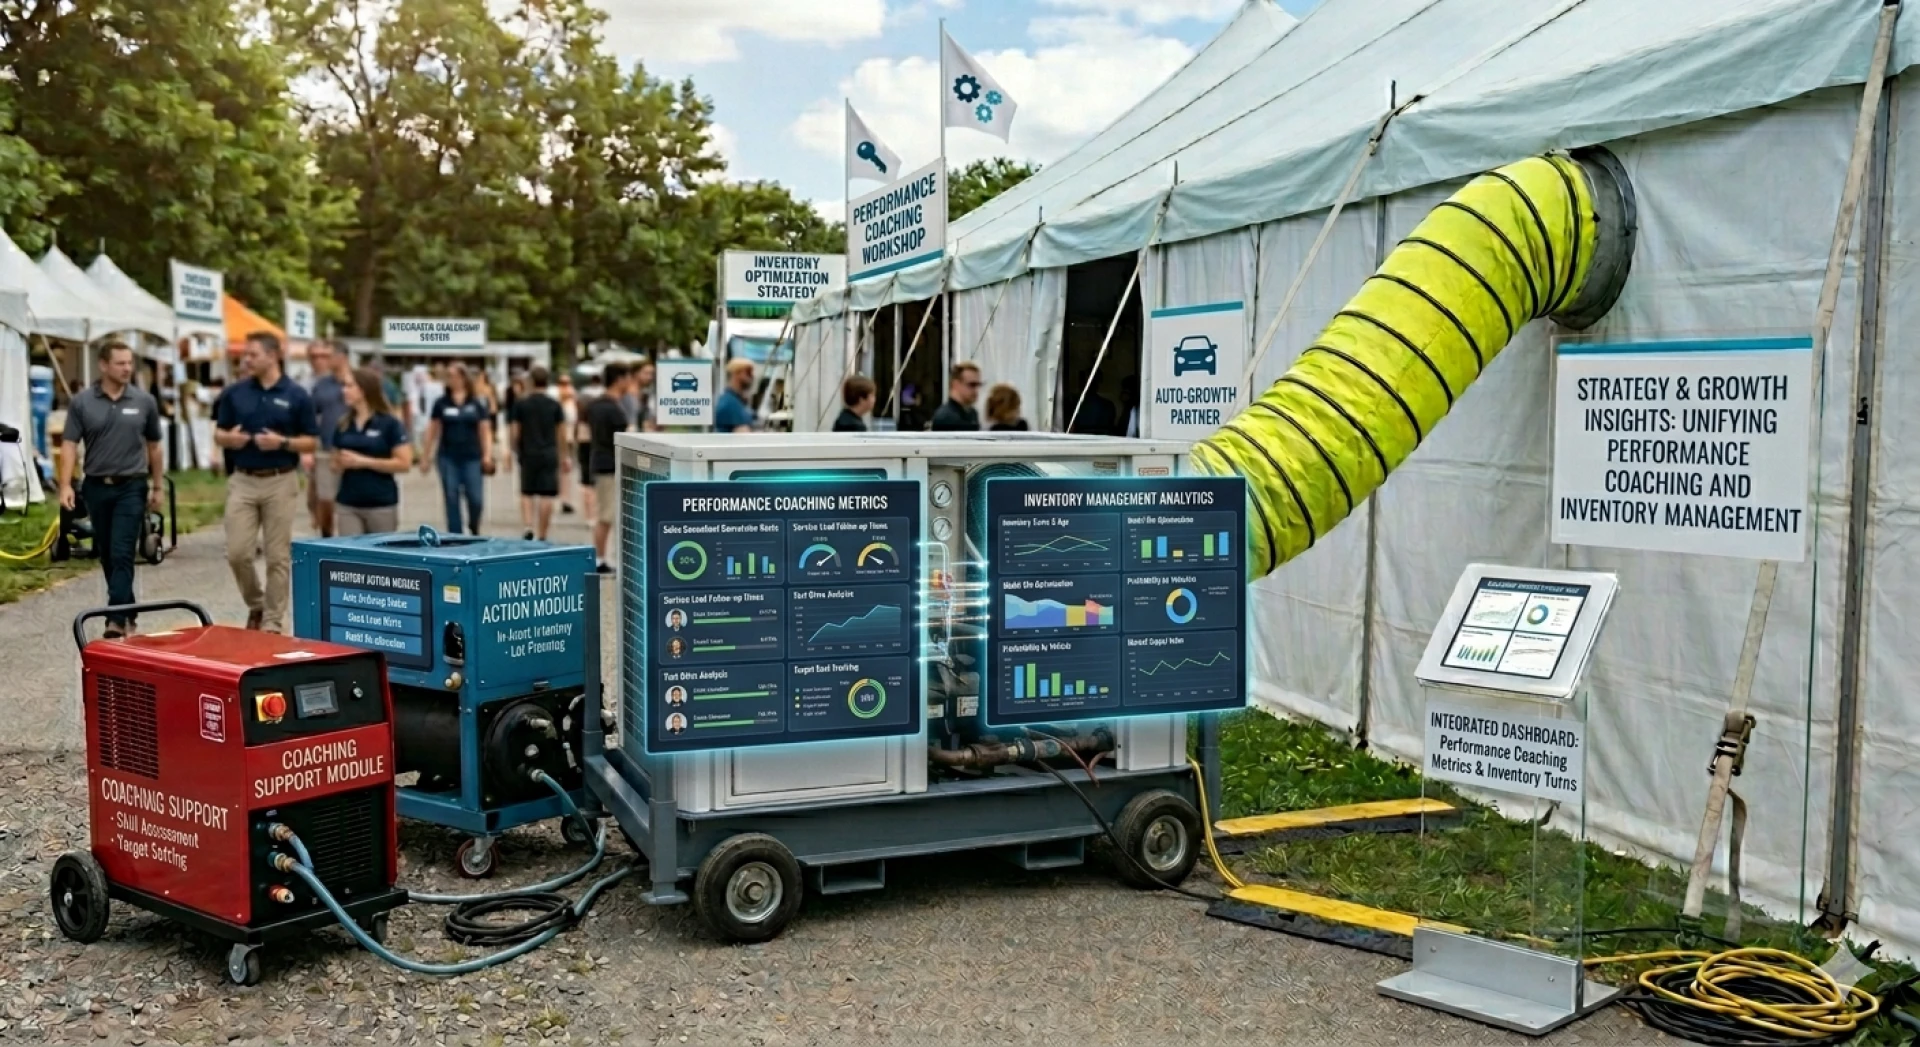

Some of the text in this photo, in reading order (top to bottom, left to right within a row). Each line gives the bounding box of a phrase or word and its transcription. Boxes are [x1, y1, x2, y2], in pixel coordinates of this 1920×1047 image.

[853, 171, 936, 226] PERFORMANCE
[865, 204, 923, 242] COACHING
[862, 227, 926, 265] WORKSHOP
[1155, 386, 1237, 404] AUTO-GROWTH
[1577, 375, 1788, 401] STRATEGY & GROWTH
[1170, 408, 1221, 425] PARTNER
[1585, 408, 1778, 434] INSIGHTS: UNIFYING
[1607, 438, 1750, 466] PERFORMANCE
[1024, 491, 1215, 507] INVENTORY MANAGEMENT ANALYTICS
[1605, 469, 1752, 499] COACHING AND
[682, 495, 889, 512] PERFORMANCE COACHING METRICS
[1560, 497, 1802, 533] INVENTORY MANAGEMENT
[498, 574, 569, 600] INVENTORY
[482, 593, 584, 624] ACTION MODULE
[282, 738, 357, 770] COACHING
[1440, 734, 1511, 760] Performance
[254, 755, 384, 799] SUPPORT MODULE
[1431, 753, 1472, 774] Metrics
[1475, 760, 1485, 777] &
[1487, 762, 1541, 788] Inventory
[168, 795, 229, 831] SUPPORT
